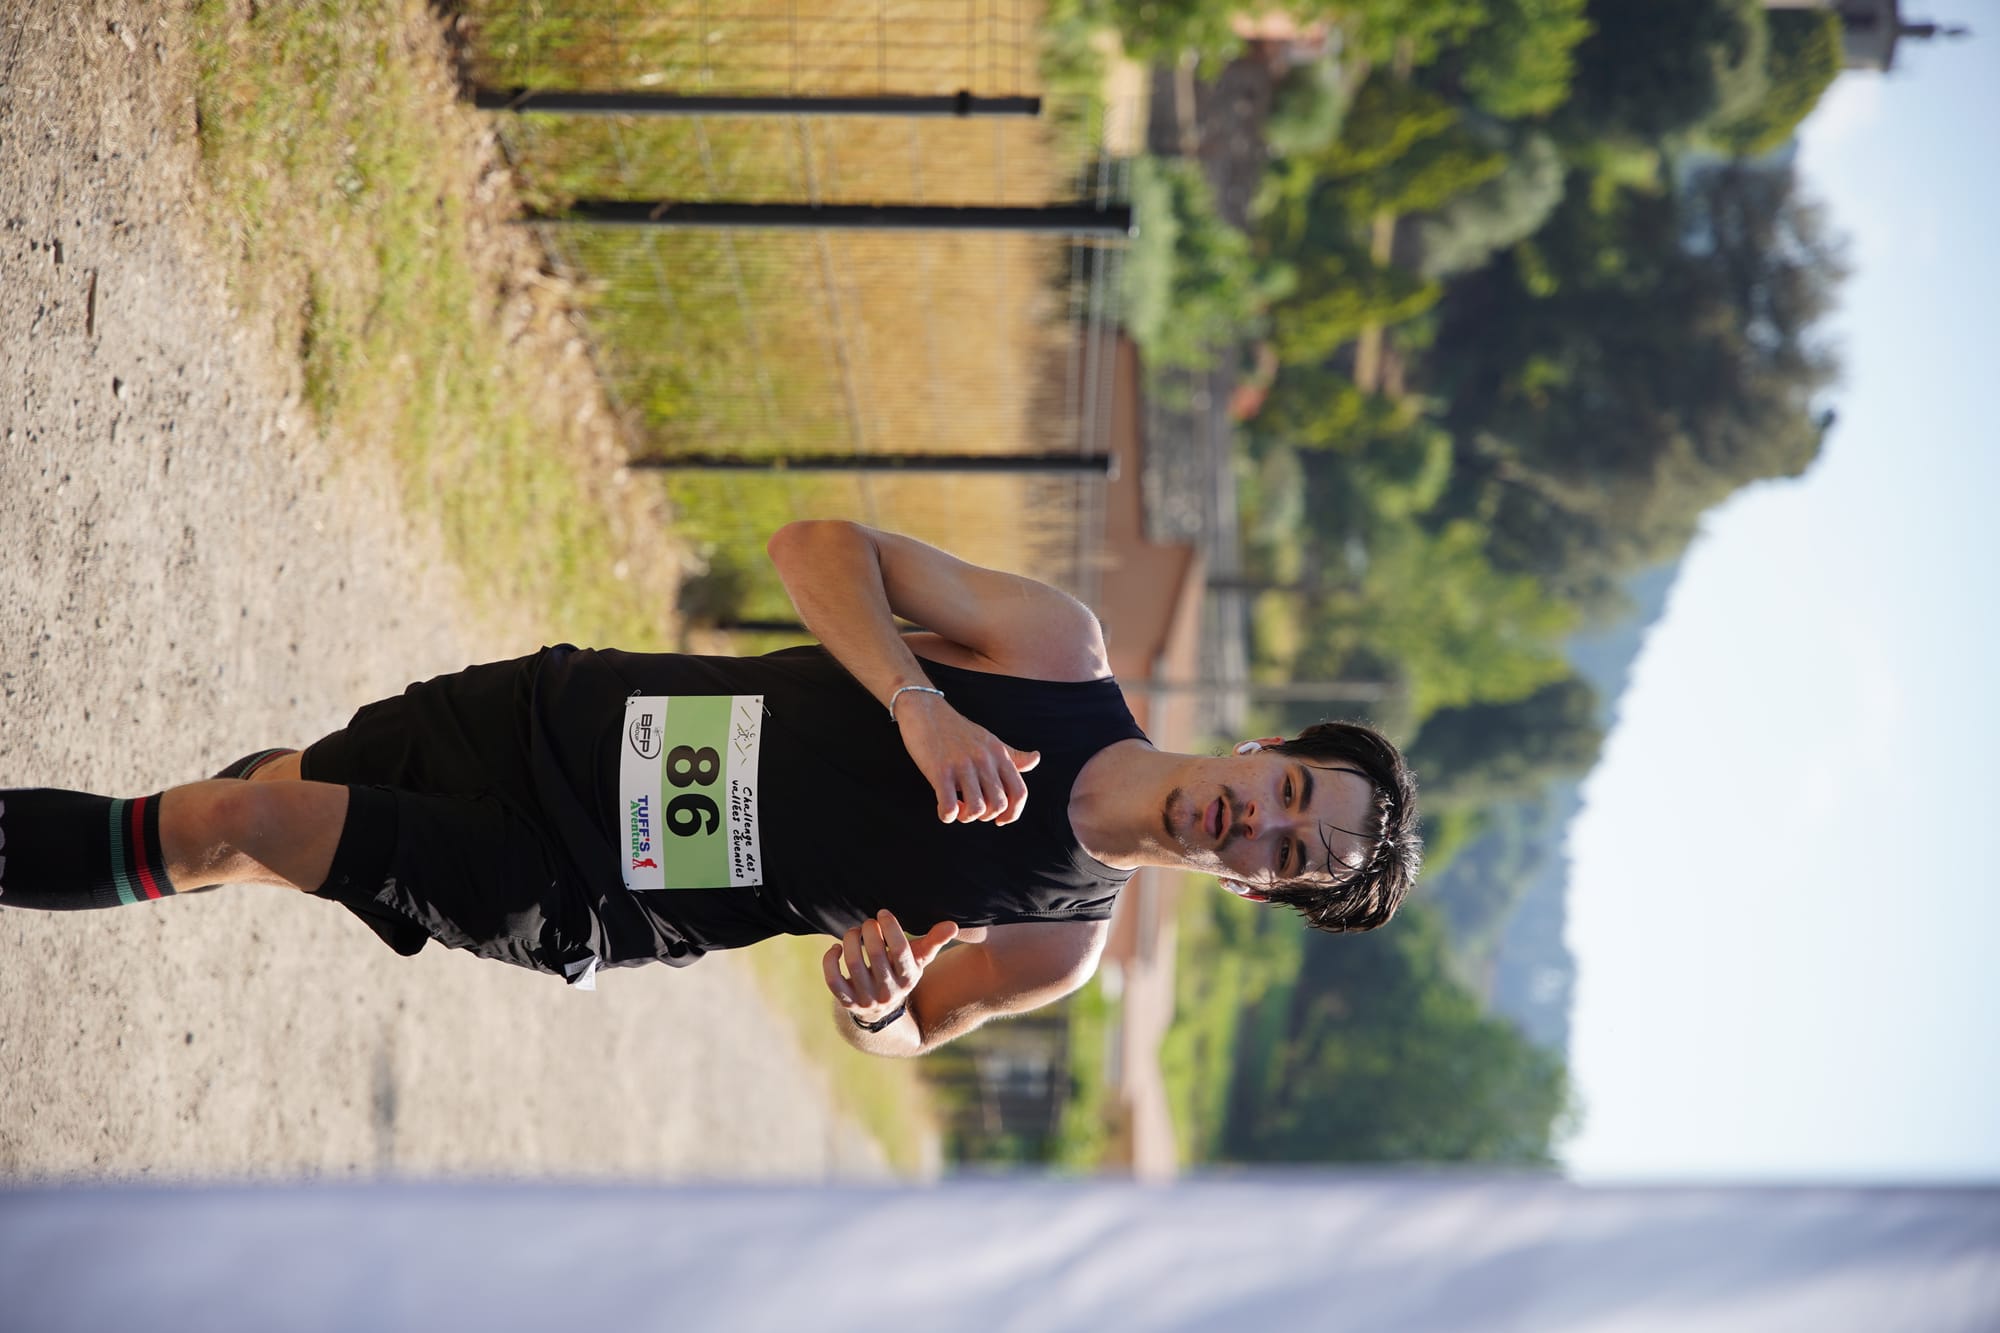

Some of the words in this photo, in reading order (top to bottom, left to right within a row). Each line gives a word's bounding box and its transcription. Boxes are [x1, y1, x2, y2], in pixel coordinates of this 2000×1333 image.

[638, 713, 653, 753] BFP
[666, 744, 721, 837] 86
[732, 780, 742, 822] vallées
[743, 786, 753, 847] Challenge
[630, 800, 640, 858] Aventure
[638, 795, 650, 852] TUFF'S
[732, 829, 744, 879] cévenoles
[746, 853, 756, 872] des
